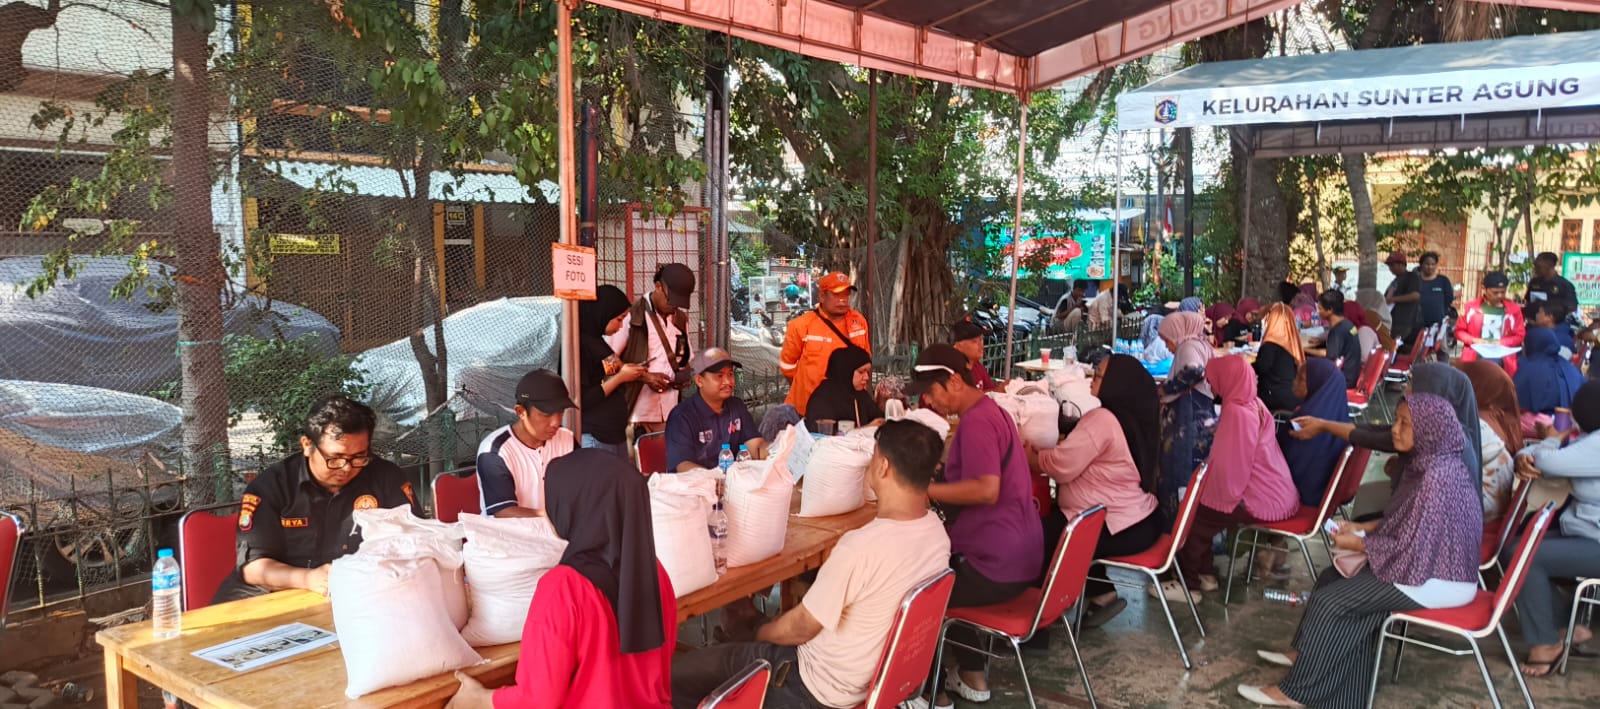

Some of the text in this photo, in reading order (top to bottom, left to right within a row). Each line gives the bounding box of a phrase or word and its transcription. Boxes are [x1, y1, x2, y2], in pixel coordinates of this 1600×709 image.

[1202, 77, 1579, 115] KELURAHAN SUNTER AGUNG
[567, 254, 584, 266] SESI
[566, 270, 586, 282] FOTO
